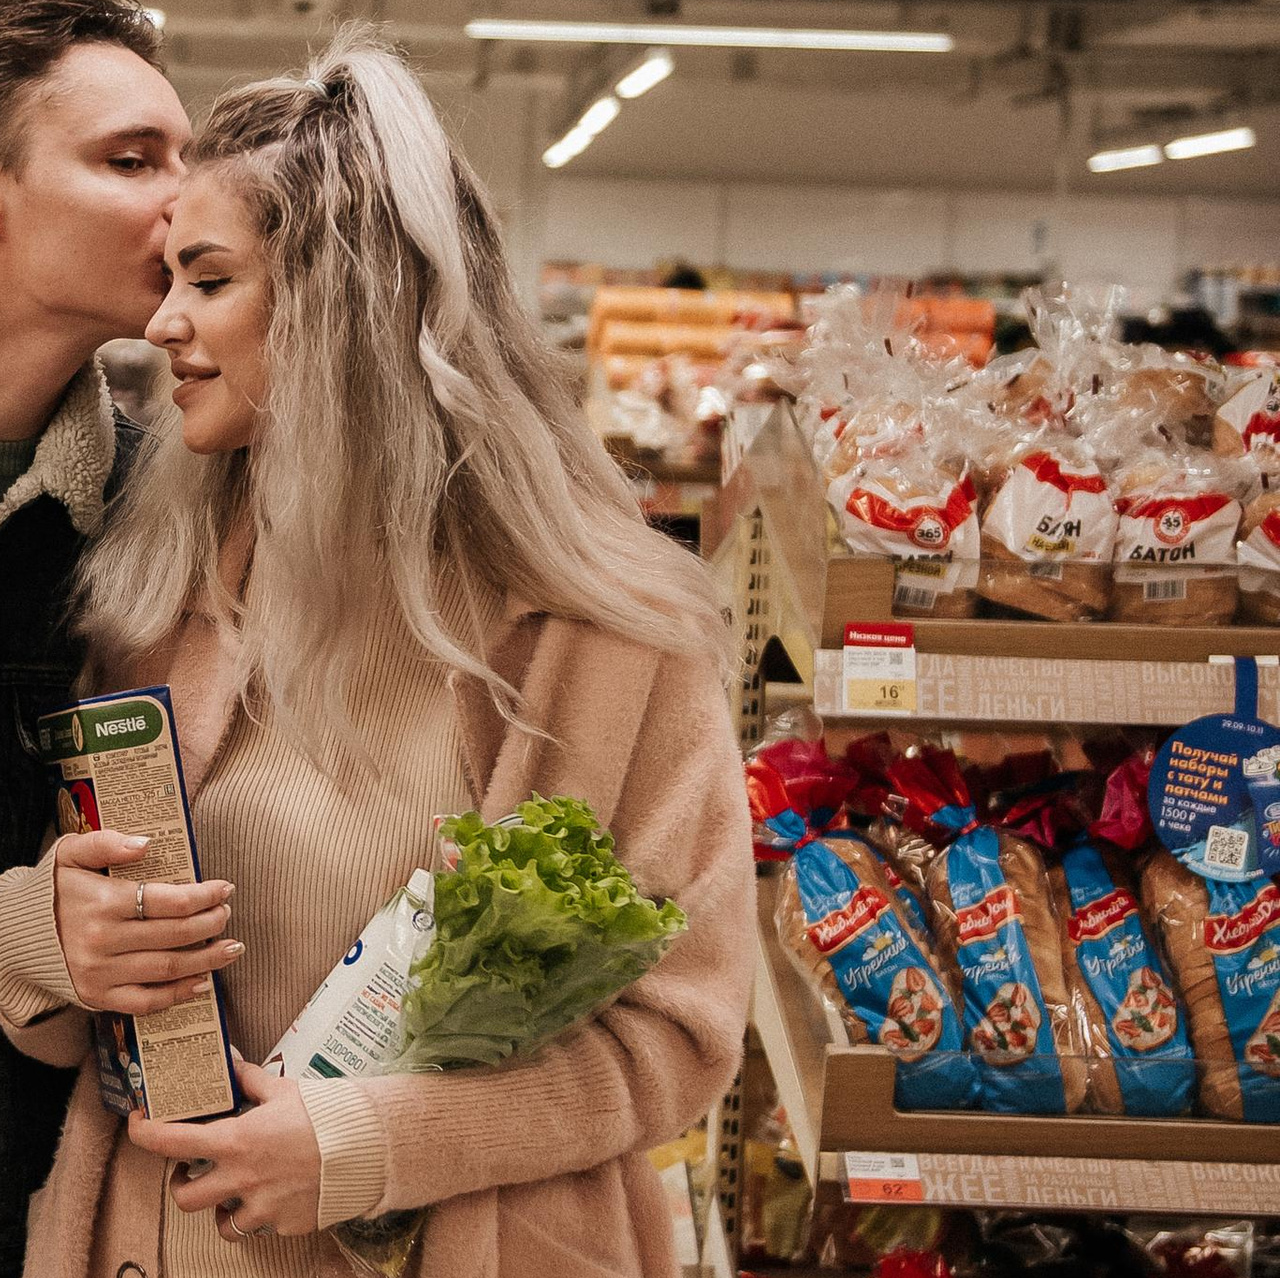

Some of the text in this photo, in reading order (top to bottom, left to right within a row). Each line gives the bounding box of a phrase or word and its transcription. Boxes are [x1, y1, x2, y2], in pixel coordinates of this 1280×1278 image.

[917, 526, 941, 538] 365
[1129, 540, 1196, 562] БАТОН
[849, 630, 907, 644] Низкая цена
[1142, 663, 1234, 685] ВЫСОКО
[880, 685, 899, 700] 16
[977, 692, 1067, 718] ДЕНЬГИ
[1172, 741, 1238, 766] Получай
[1170, 758, 1228, 778] наборы
[1178, 773, 1211, 789] тату
[1213, 780, 1222, 789] и
[1163, 796, 1174, 806] за
[1165, 784, 1228, 805] патчами
[1161, 805, 1188, 821] 1500
[323, 1034, 368, 1072] ЗДОРОВО!
[883, 1183, 903, 1196] 62
